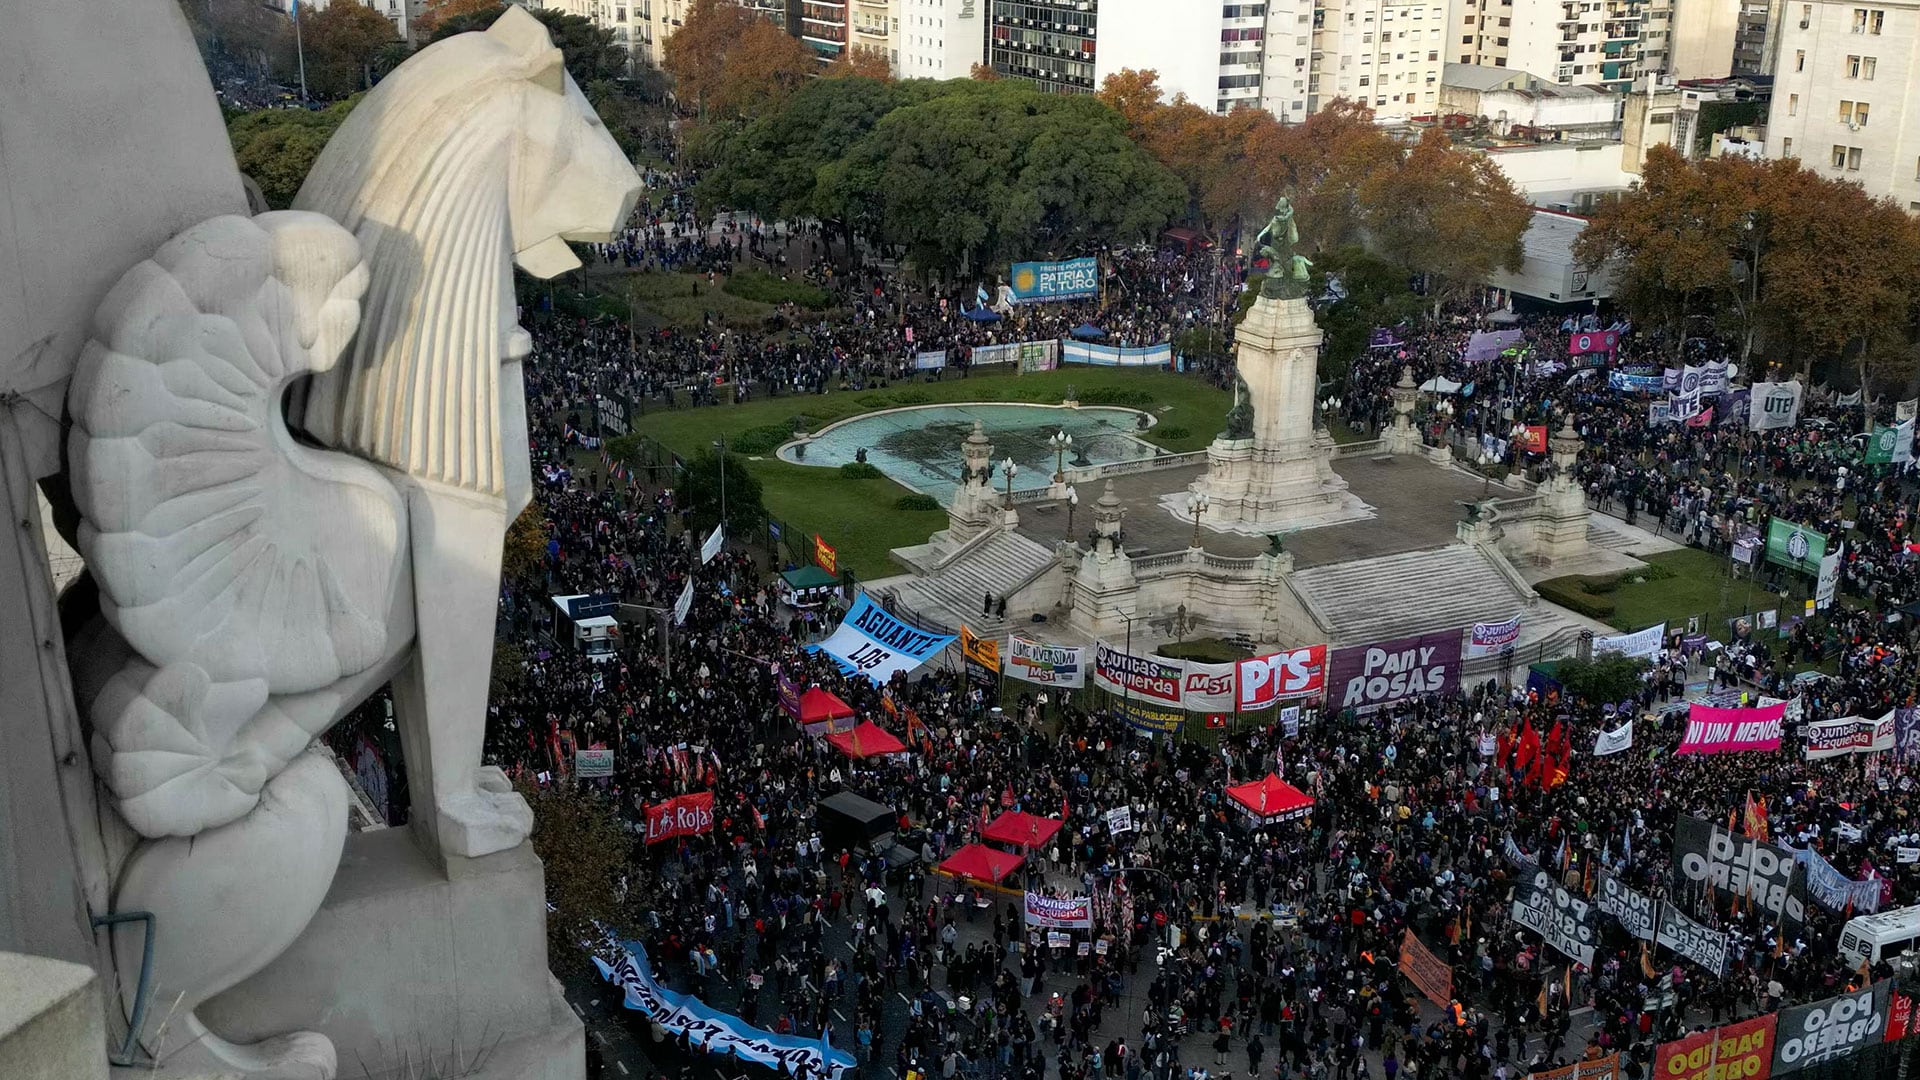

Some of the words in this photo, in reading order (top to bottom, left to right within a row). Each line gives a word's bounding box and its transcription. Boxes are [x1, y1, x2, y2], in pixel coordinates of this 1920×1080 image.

[1040, 269, 1085, 283] PATRIA
[1086, 268, 1095, 278] Y
[1065, 261, 1096, 270] POPULAR
[1040, 278, 1096, 293] FUTURO
[854, 604, 945, 656] AGUANTE
[847, 642, 891, 669] LOS
[1013, 639, 1031, 657] LIBRE
[1032, 646, 1076, 665] DIVERSIDAD
[1030, 666, 1056, 681] MST
[1189, 676, 1232, 694] MST
[1240, 649, 1311, 703] PTS
[1342, 665, 1446, 707] ROSAS
[1684, 720, 1704, 744] NI
[1704, 721, 1734, 744] UNA
[1733, 717, 1783, 743] MENOS
[1818, 733, 1869, 749] izquierda
[676, 1012, 724, 1037] LOS
